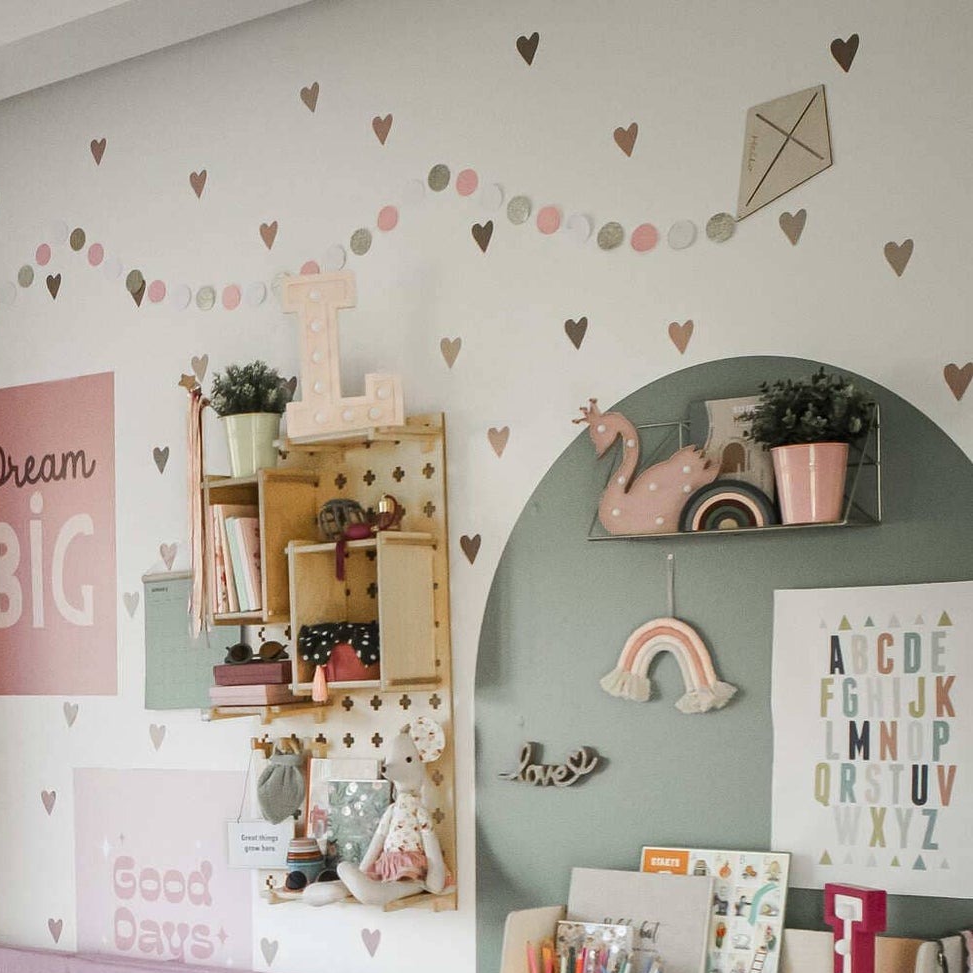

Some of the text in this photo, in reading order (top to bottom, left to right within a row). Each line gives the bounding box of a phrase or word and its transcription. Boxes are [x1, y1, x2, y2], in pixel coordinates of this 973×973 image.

[283, 270, 404, 439] L
[259, 834, 279, 843] things
[261, 844, 276, 852] here
[113, 855, 213, 907] Good
[113, 906, 215, 962] Days
